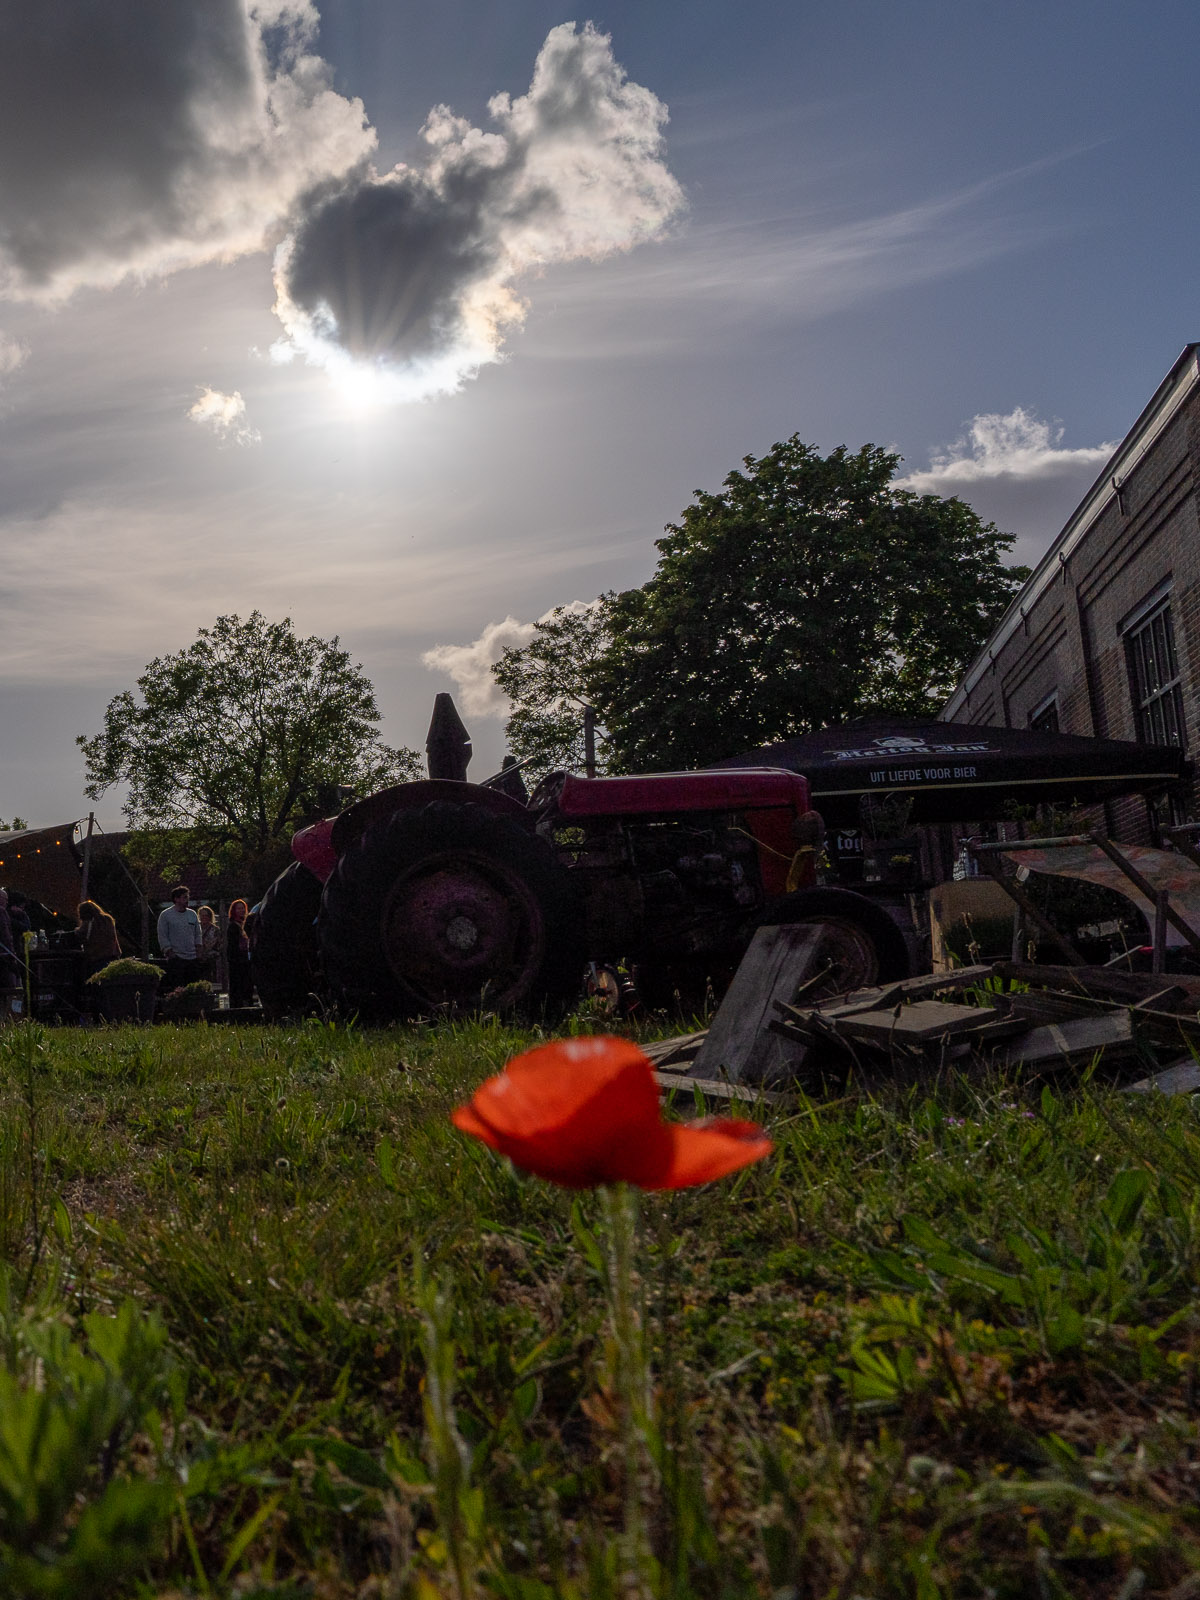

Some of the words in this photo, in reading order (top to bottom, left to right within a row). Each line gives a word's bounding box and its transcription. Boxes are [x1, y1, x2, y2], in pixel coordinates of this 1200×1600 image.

[870, 770, 886, 783] UIT
[888, 769, 923, 782] LIEFDE
[923, 767, 952, 780] VOOR
[953, 766, 977, 778] BIER
